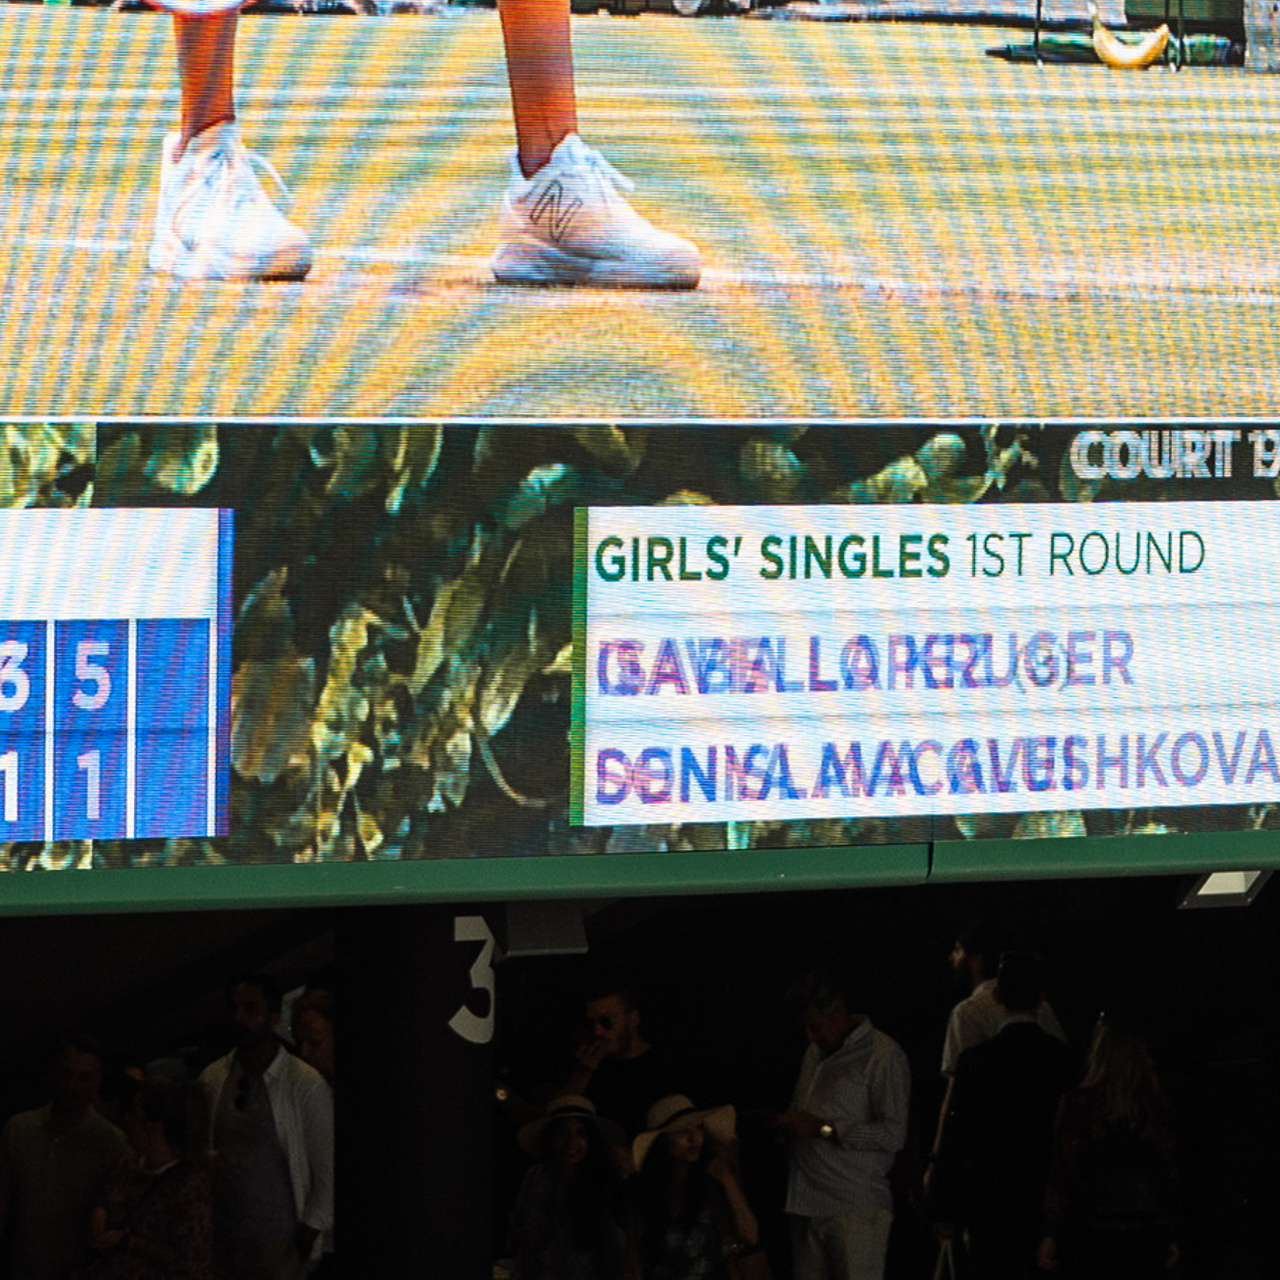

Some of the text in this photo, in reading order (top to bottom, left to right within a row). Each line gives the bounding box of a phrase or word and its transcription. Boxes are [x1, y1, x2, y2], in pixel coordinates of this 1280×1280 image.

[1070, 430, 1241, 479] COURT
[596, 530, 1206, 582] GIRLS' SINGLES 1ST ROUND
[72, 641, 111, 709] 5
[76, 749, 100, 819] 1
